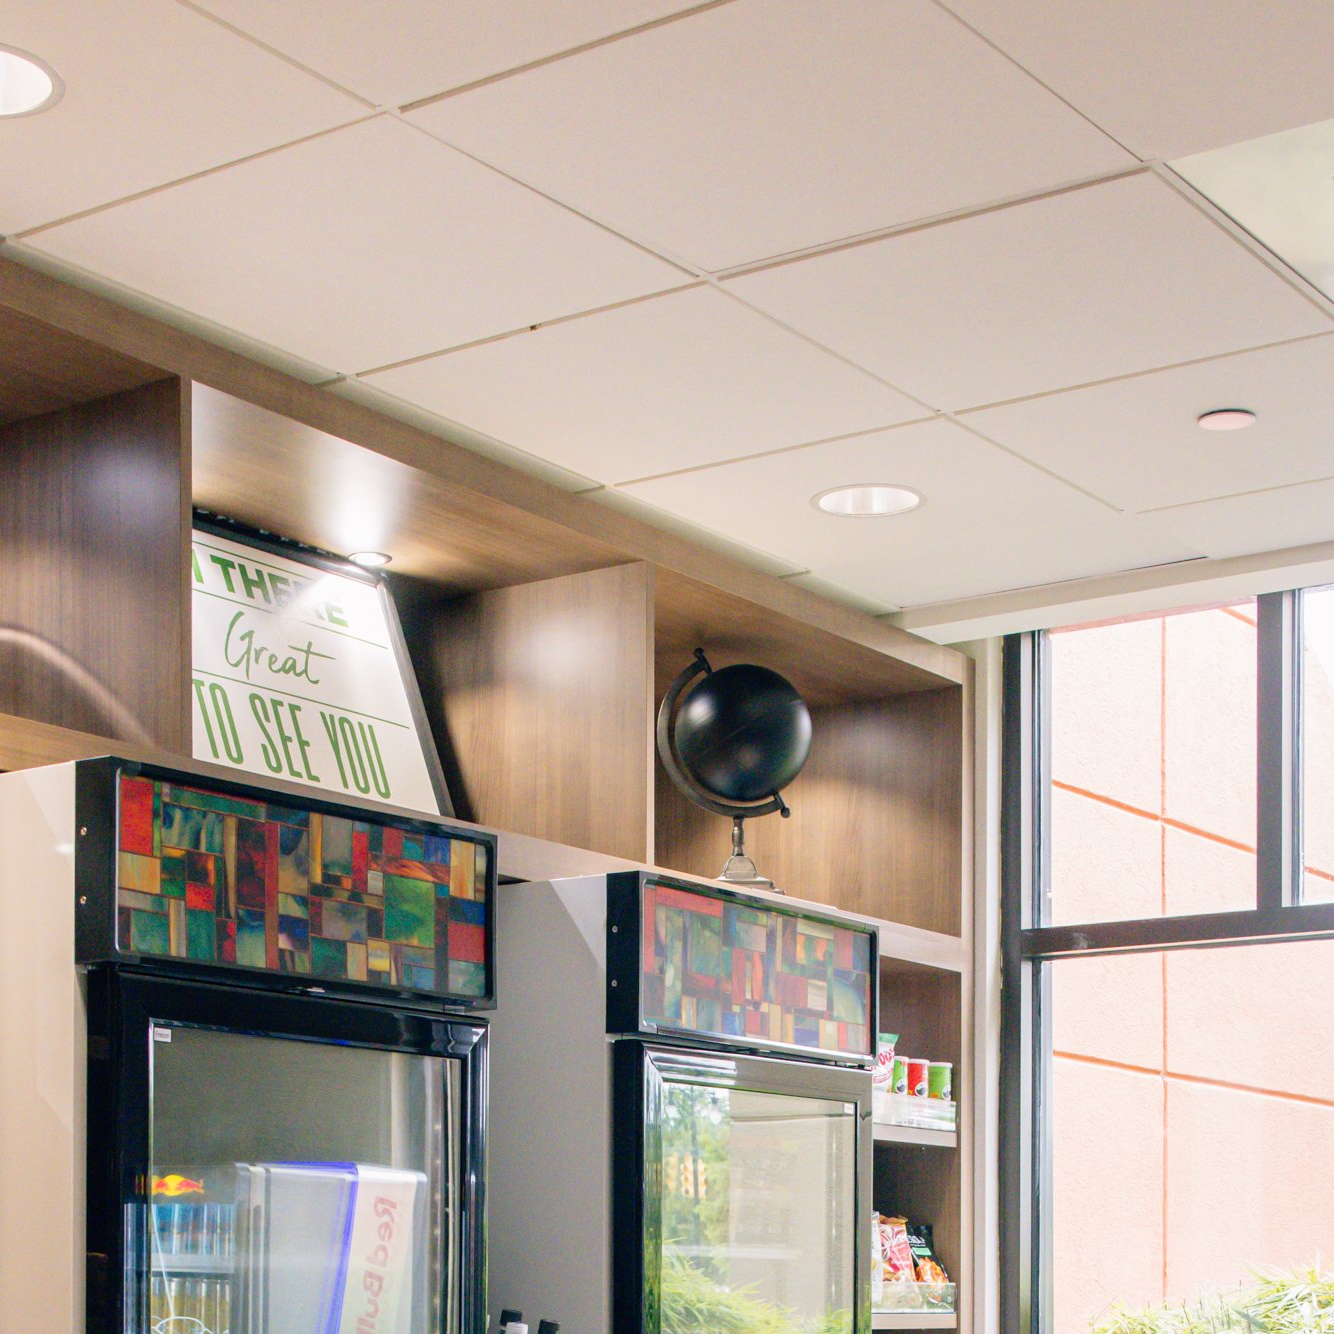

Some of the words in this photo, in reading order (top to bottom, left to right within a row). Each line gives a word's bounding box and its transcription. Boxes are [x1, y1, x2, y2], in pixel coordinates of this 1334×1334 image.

[210, 554, 349, 627] THEE
[224, 611, 336, 685] Great
[193, 678, 244, 765] TO
[249, 693, 321, 783] SEE
[319, 710, 391, 800] YOU
